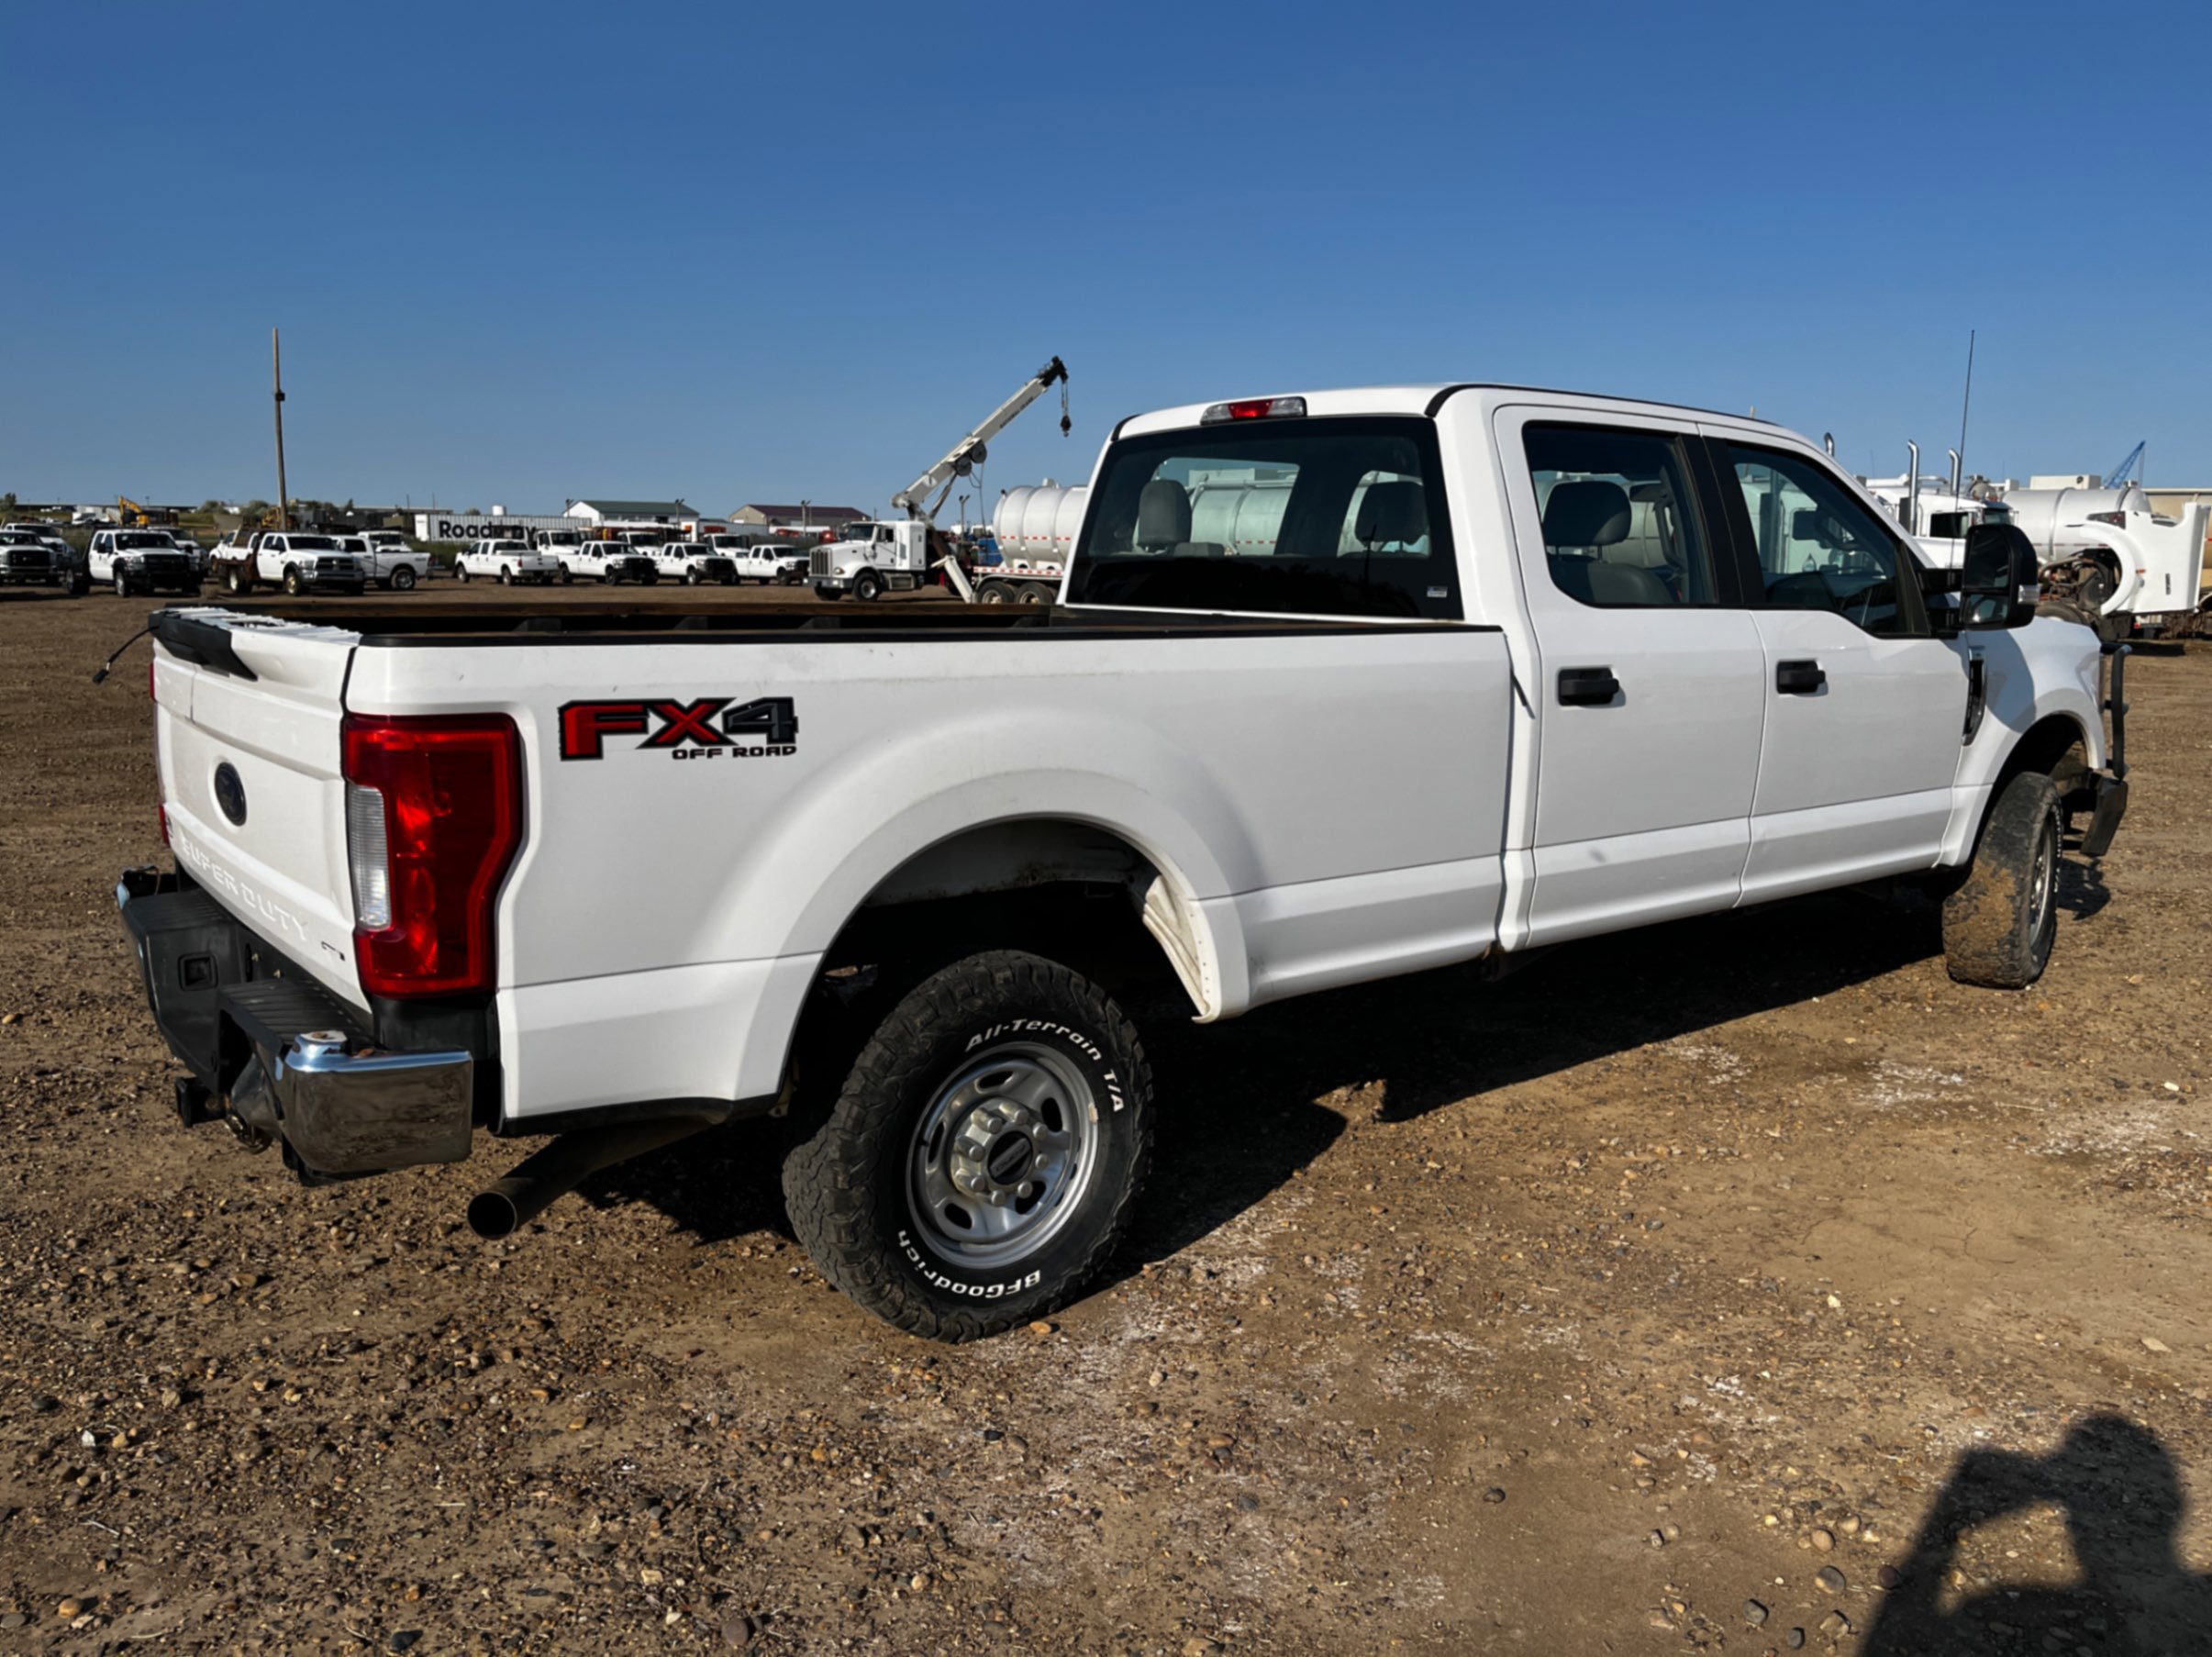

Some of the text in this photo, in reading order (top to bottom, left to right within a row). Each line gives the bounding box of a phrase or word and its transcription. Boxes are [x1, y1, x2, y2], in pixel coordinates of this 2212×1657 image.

[557, 697, 798, 761] FX4
[672, 745, 797, 760] OFF ROAD
[240, 883, 306, 941] DUTY
[965, 1018, 1125, 1113] All-Terrain T/A
[897, 1229, 1041, 1299] BFGoodrich
